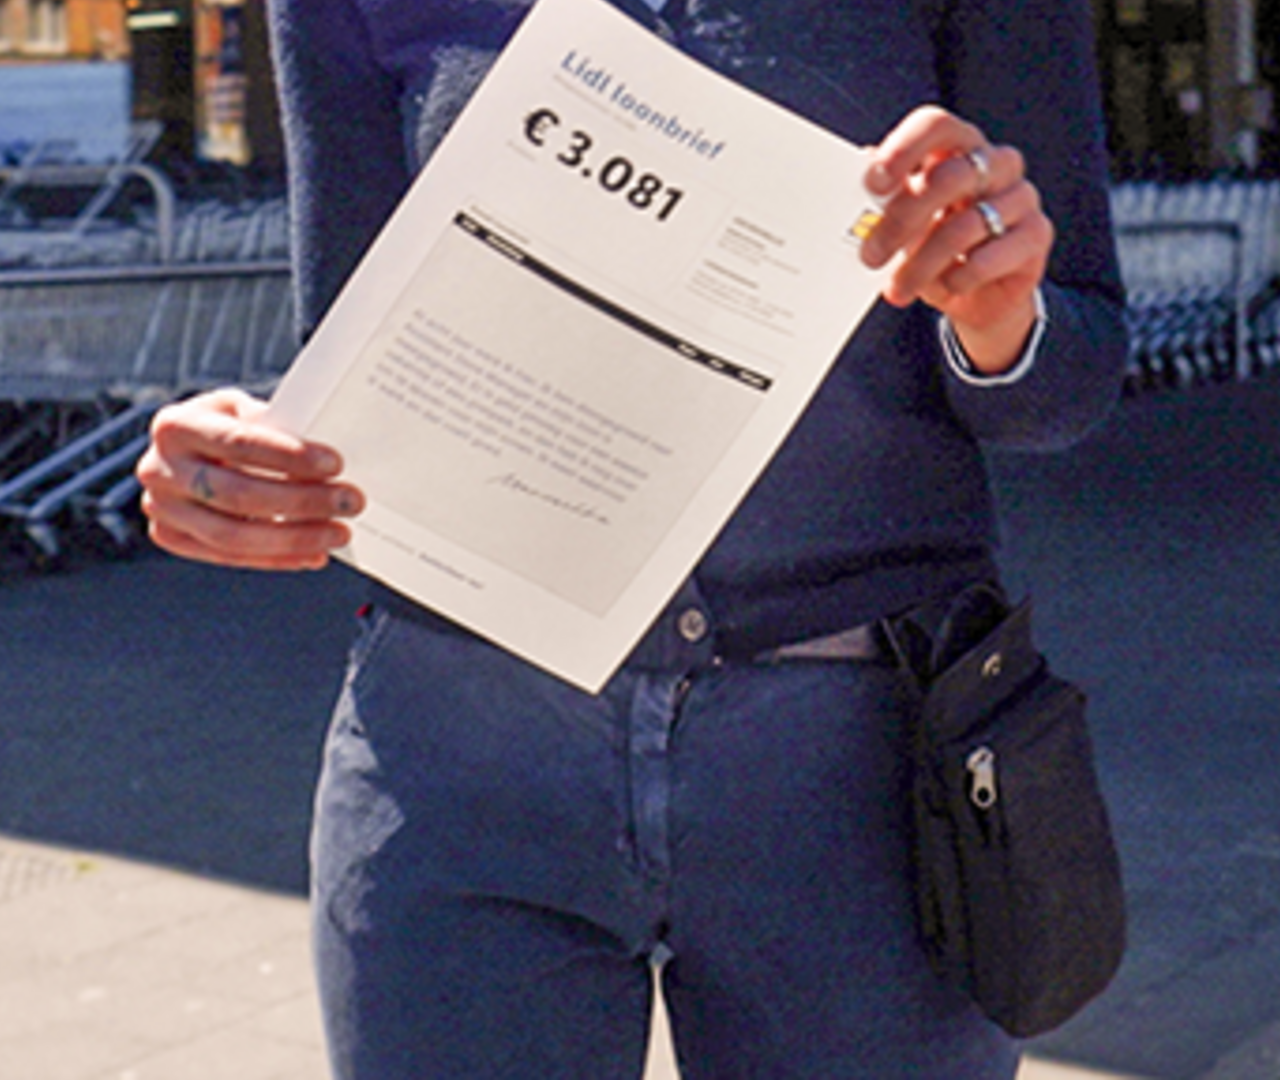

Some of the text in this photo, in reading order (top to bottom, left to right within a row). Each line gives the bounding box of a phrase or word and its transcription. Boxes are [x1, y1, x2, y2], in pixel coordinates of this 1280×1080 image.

[561, 51, 611, 93] Lidl
[611, 84, 724, 158] loonbrief
[524, 107, 683, 221] € 3.081
